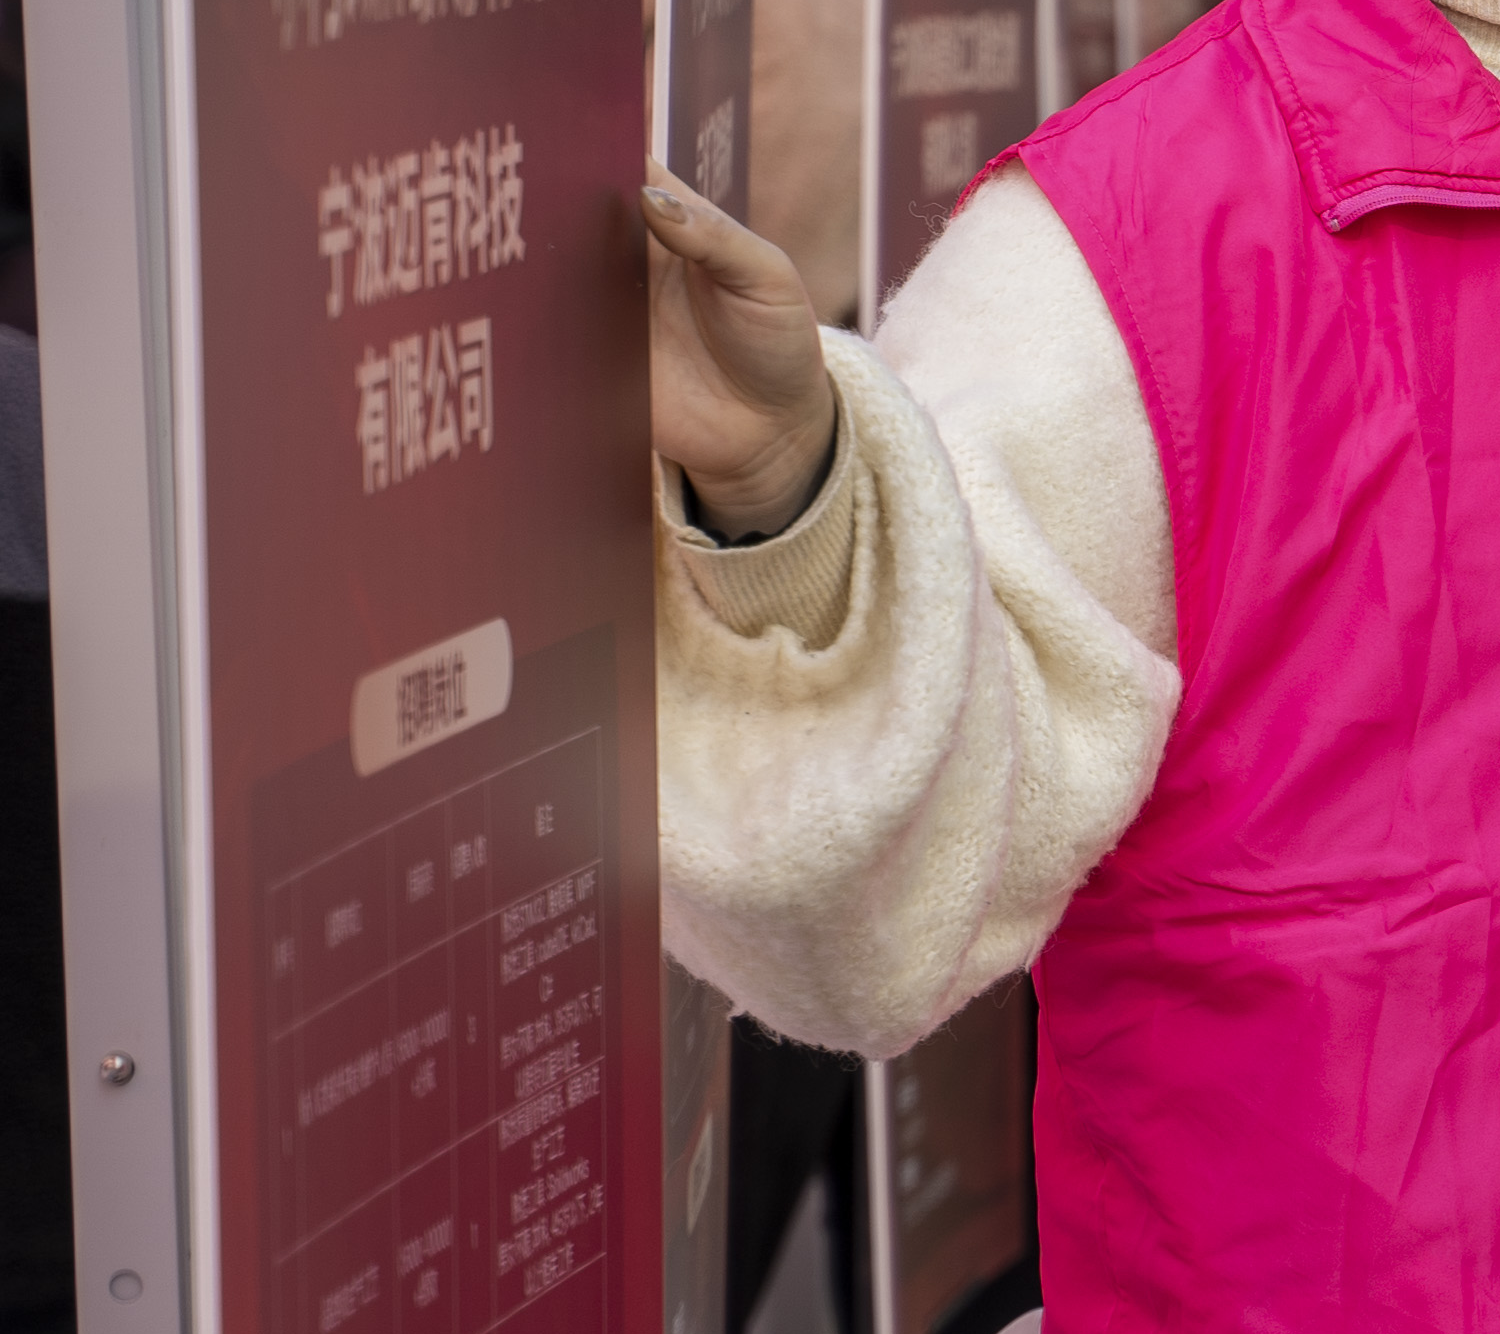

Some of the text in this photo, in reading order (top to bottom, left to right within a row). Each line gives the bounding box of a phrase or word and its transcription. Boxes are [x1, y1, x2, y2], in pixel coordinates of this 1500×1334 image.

[319, 125, 524, 318] 宁波迈肯科技
[356, 314, 494, 494] 有限公司
